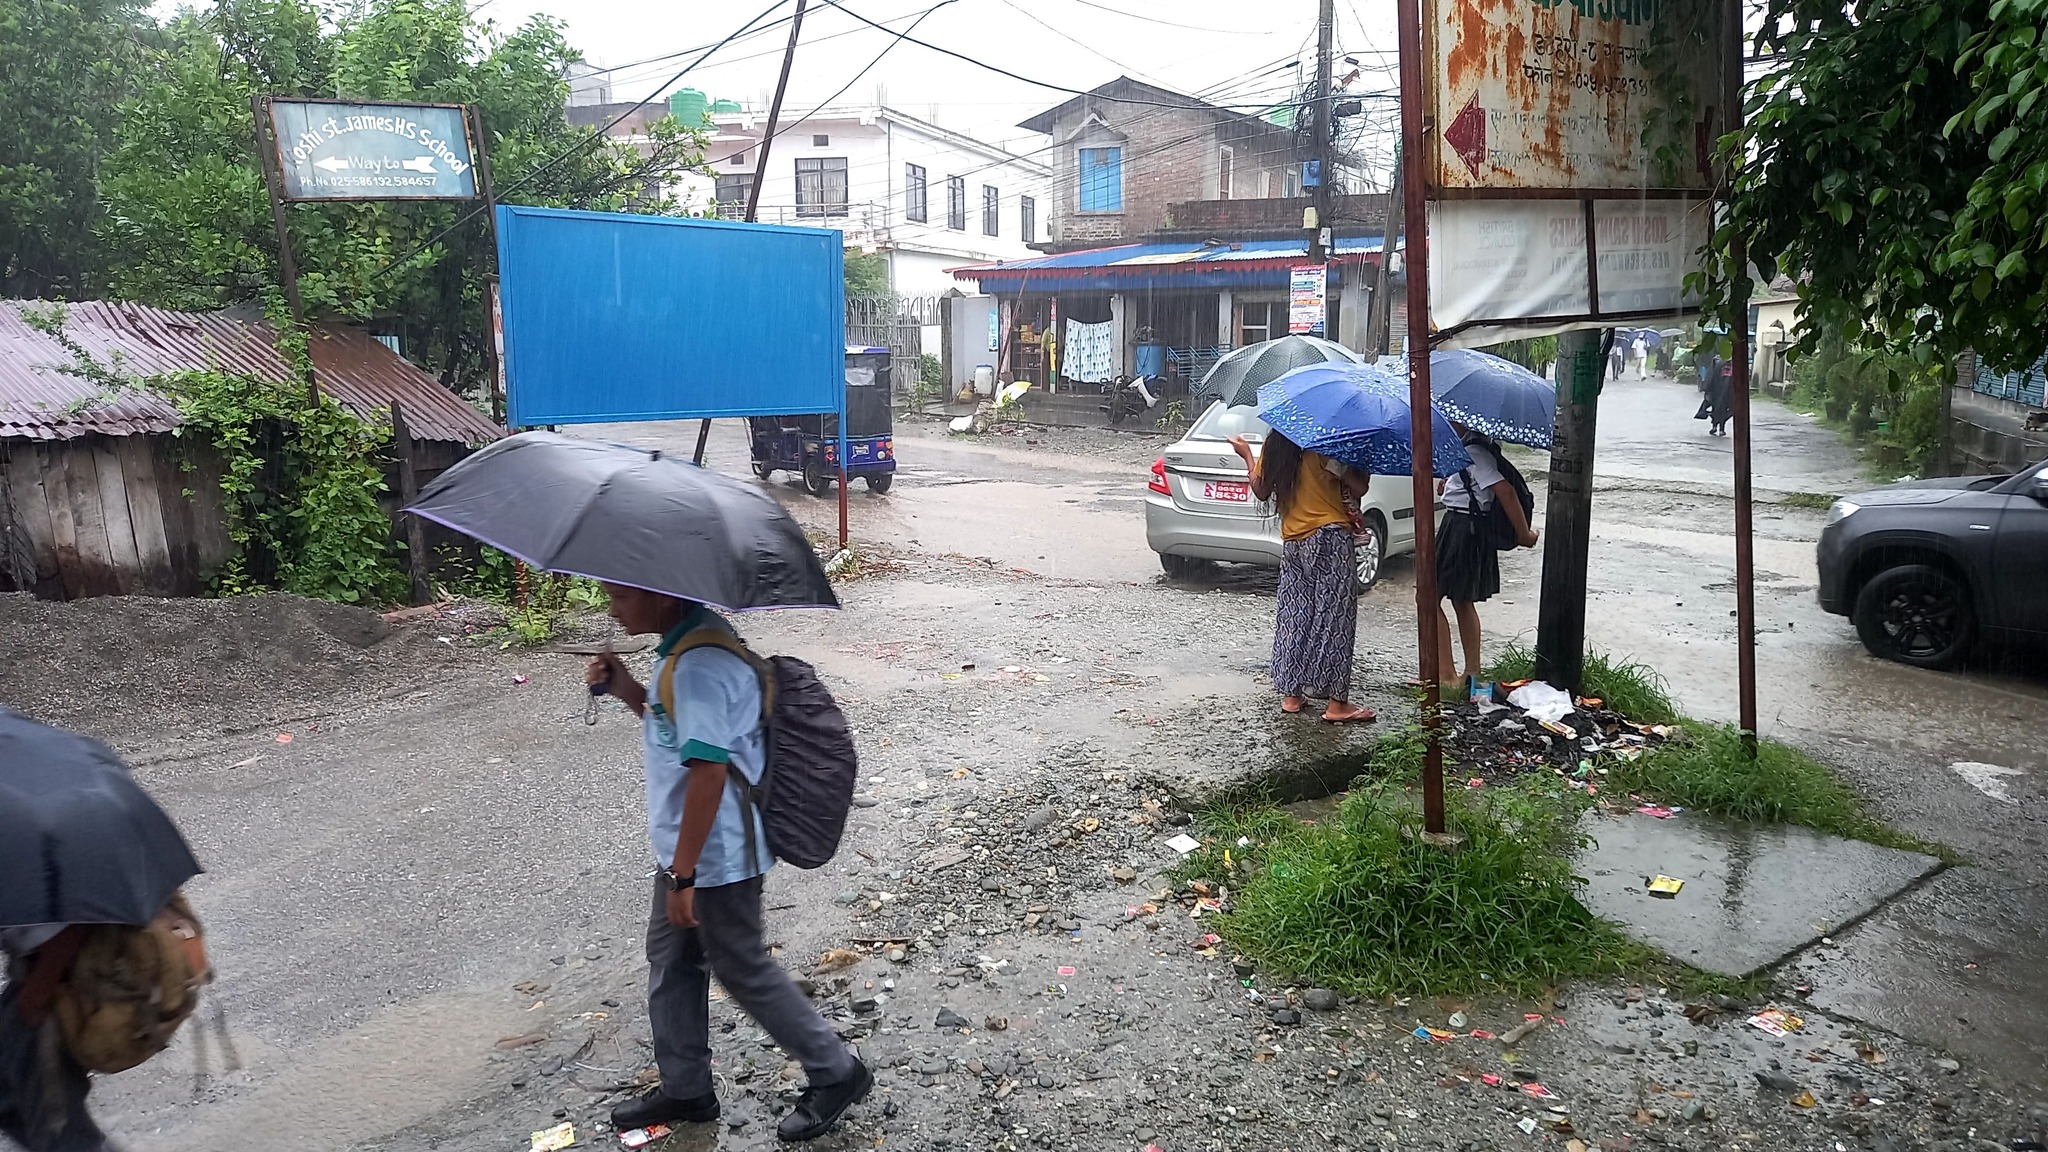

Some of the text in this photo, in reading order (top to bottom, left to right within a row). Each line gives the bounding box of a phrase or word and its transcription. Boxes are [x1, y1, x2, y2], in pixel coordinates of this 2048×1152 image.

[348, 154, 400, 174] Way to
[418, 129, 470, 176] School
